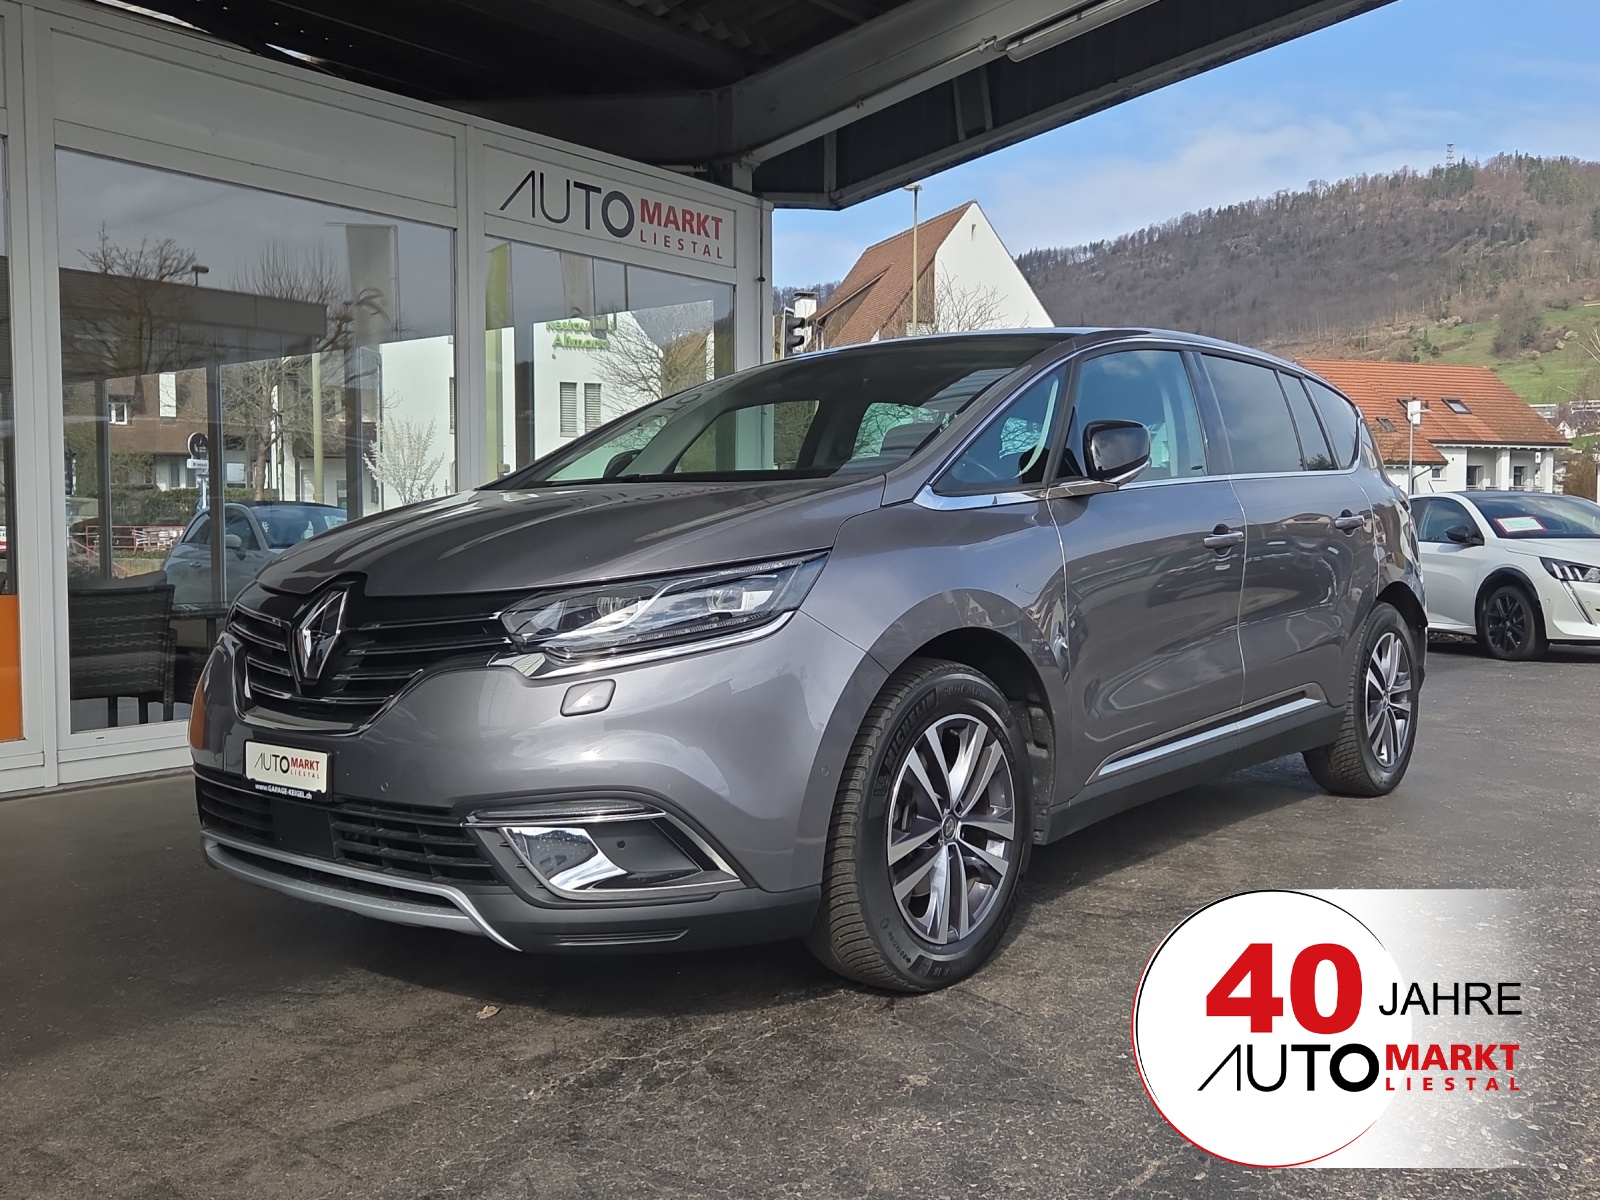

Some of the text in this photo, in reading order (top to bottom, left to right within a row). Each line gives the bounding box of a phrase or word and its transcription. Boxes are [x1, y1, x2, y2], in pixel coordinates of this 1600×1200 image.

[640, 198, 723, 241] MARKT
[640, 229, 723, 260] LIESTAL
[884, 690, 937, 770] MICHELIN
[290, 770, 320, 780] LIESTAL
